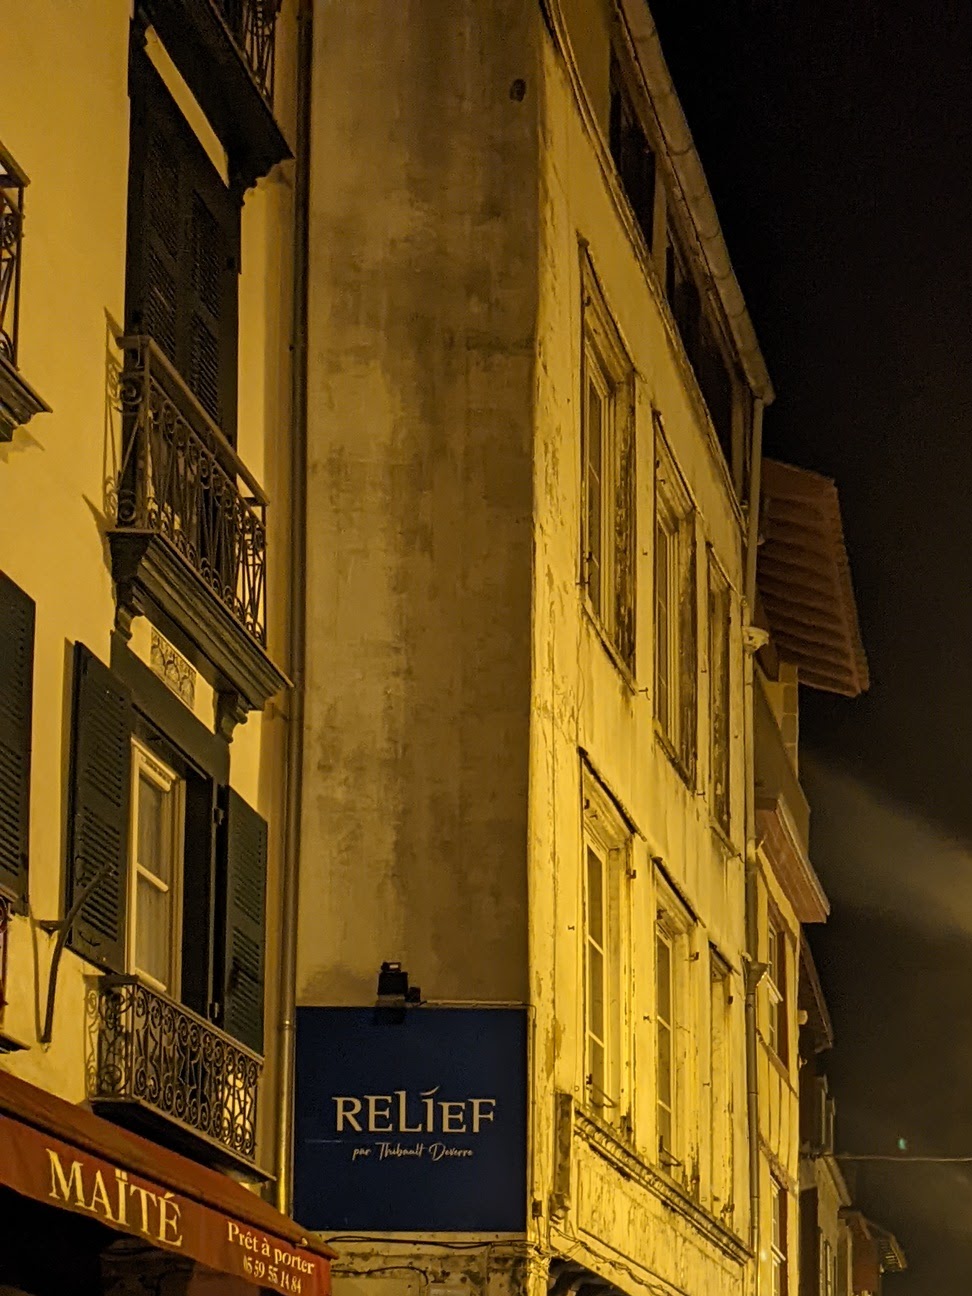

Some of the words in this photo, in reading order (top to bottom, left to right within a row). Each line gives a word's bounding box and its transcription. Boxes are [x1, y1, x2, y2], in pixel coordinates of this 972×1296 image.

[352, 1147, 372, 1161] par
[46, 1148, 182, 1246] MAÏTÉ
[228, 1221, 259, 1253] Prêt
[261, 1237, 271, 1257] à
[274, 1248, 315, 1274] porter
[243, 1255, 253, 1274] 05
[254, 1260, 265, 1278] 59
[291, 1276, 302, 1294] 84
